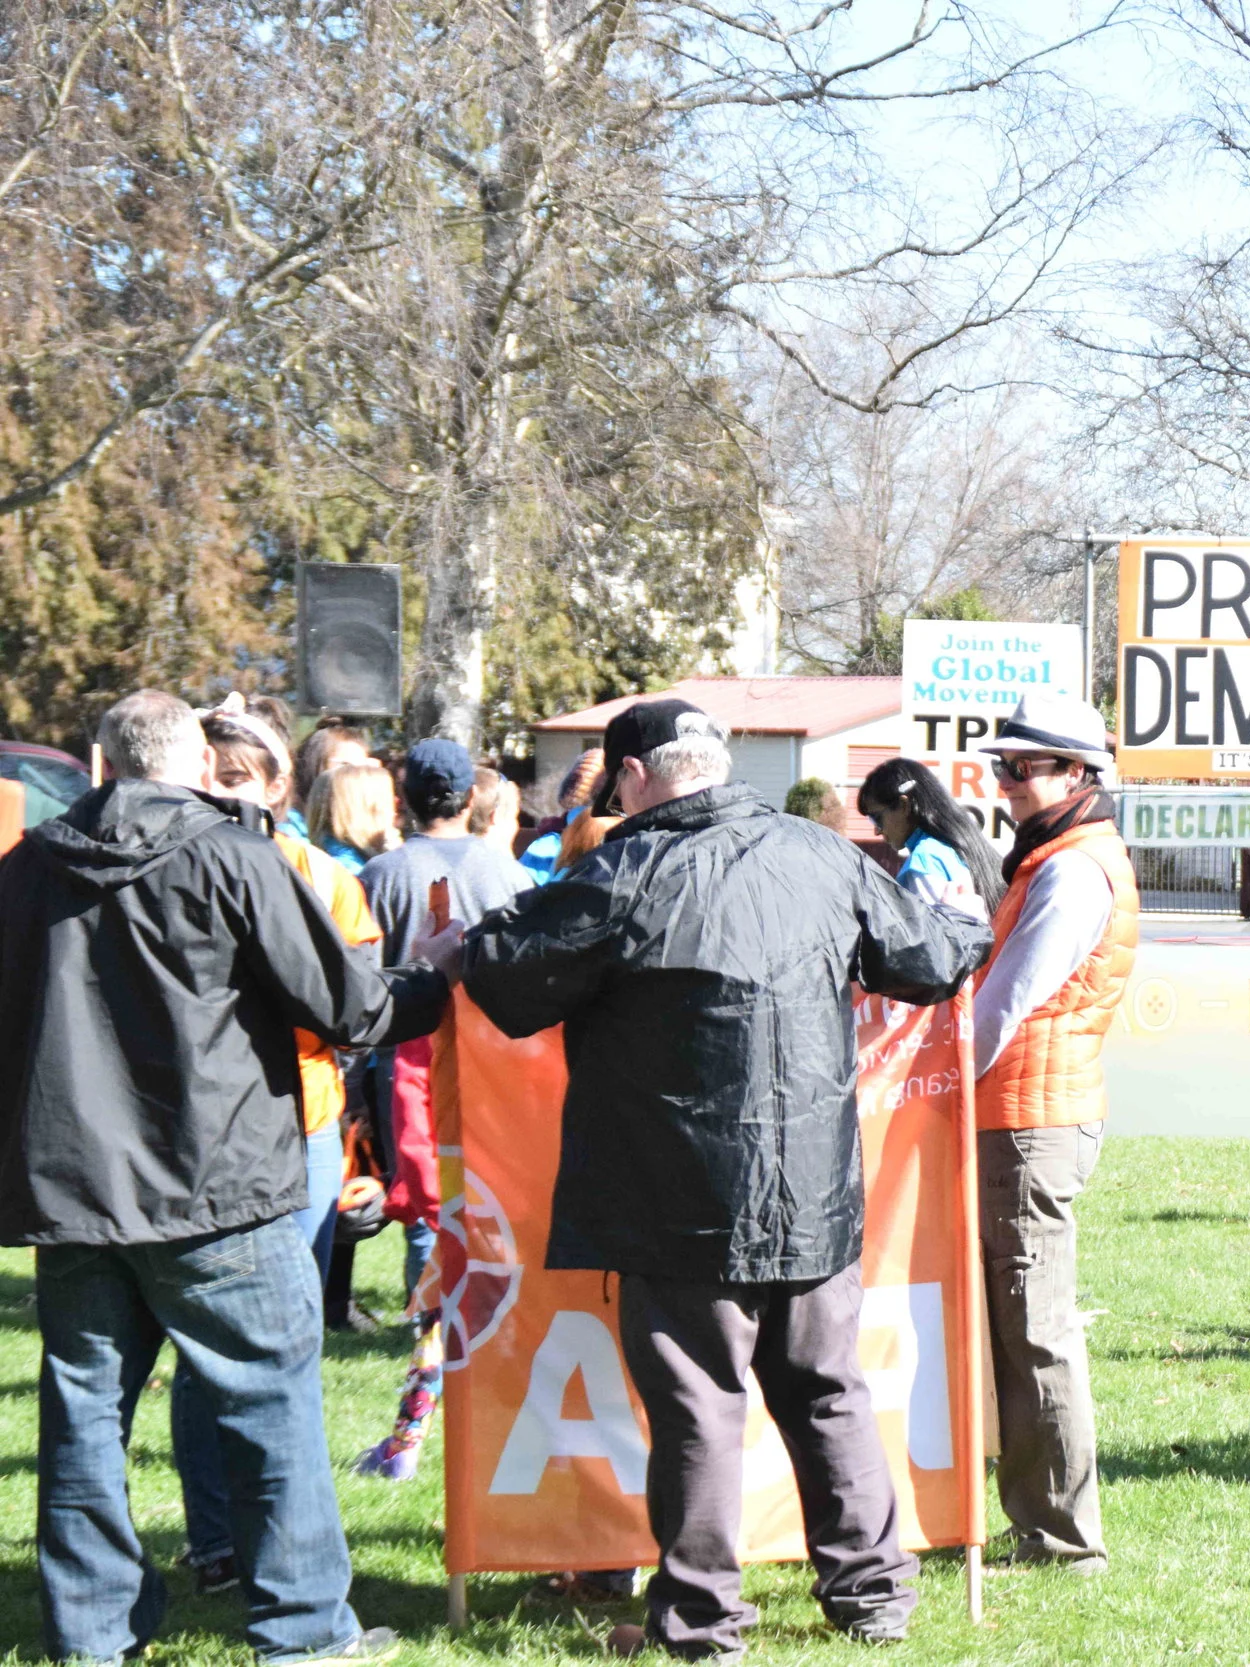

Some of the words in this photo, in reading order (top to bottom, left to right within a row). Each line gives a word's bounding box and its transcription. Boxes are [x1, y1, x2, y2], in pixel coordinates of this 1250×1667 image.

[940, 633, 995, 652] Join
[1003, 636, 1042, 653] the
[931, 655, 1051, 684] Global
[912, 681, 1068, 705] Movem
